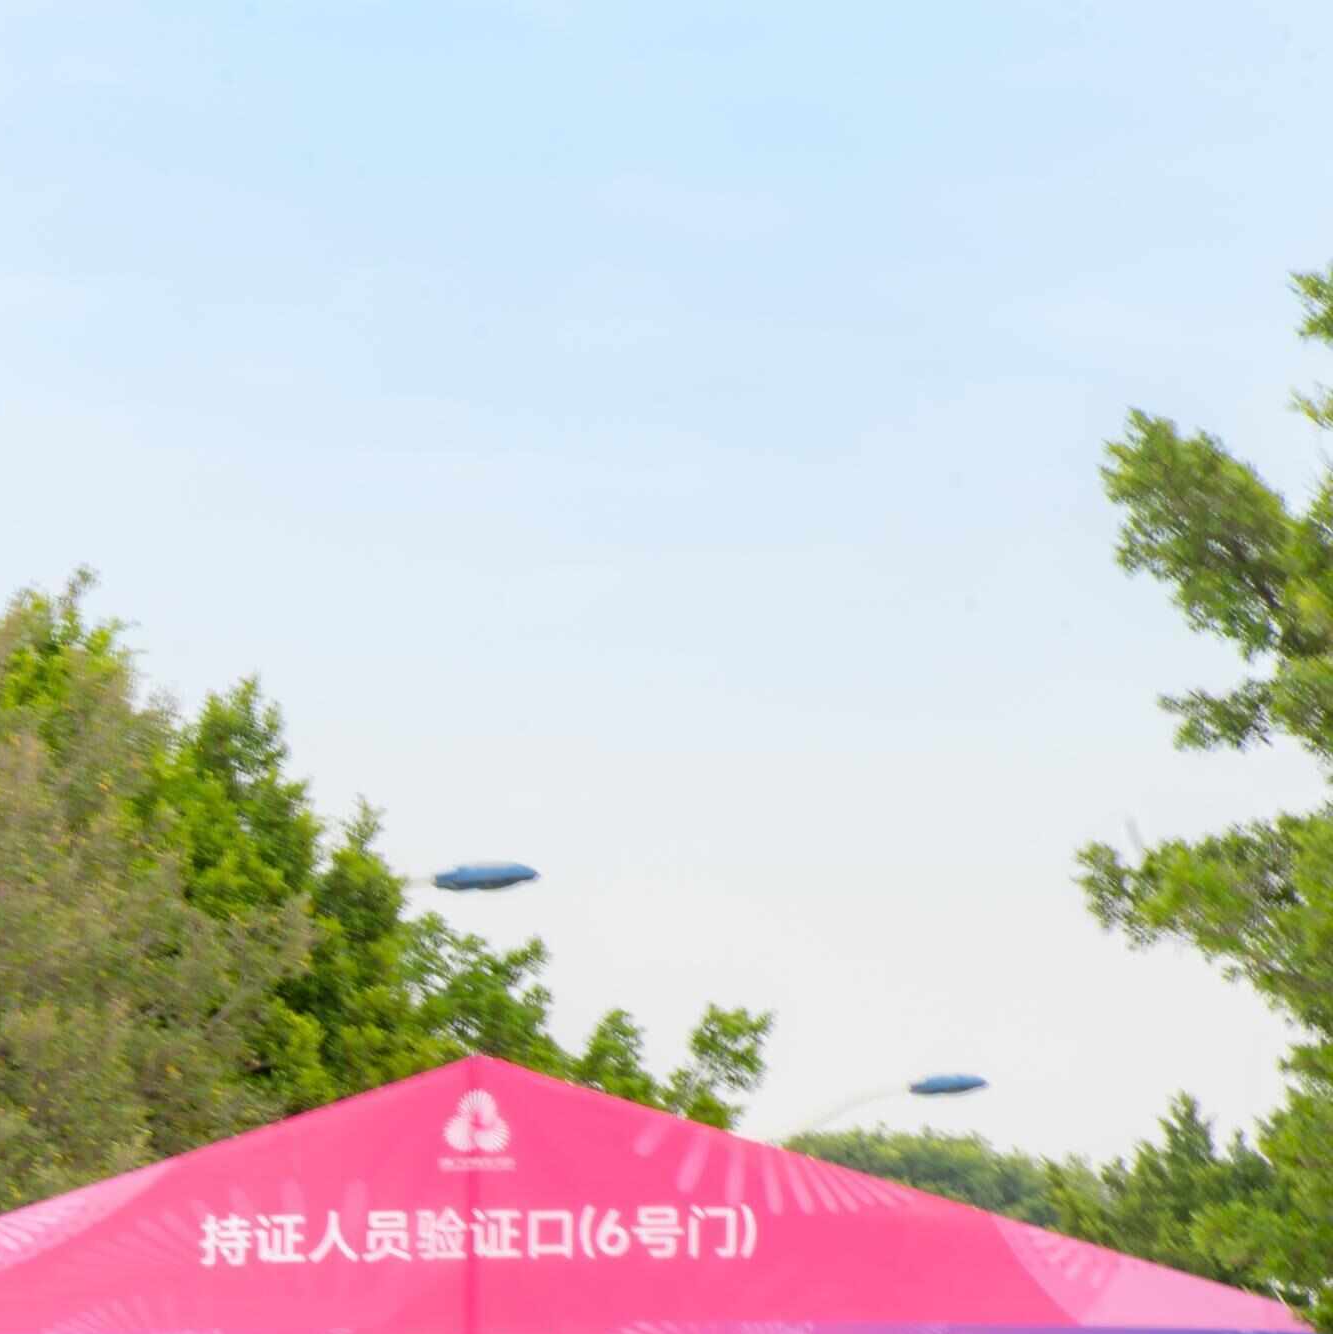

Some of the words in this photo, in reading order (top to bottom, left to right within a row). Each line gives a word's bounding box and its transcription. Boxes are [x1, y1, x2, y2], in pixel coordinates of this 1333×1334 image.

[199, 1203, 757, 1267] 持证人员验证口(6号门)
